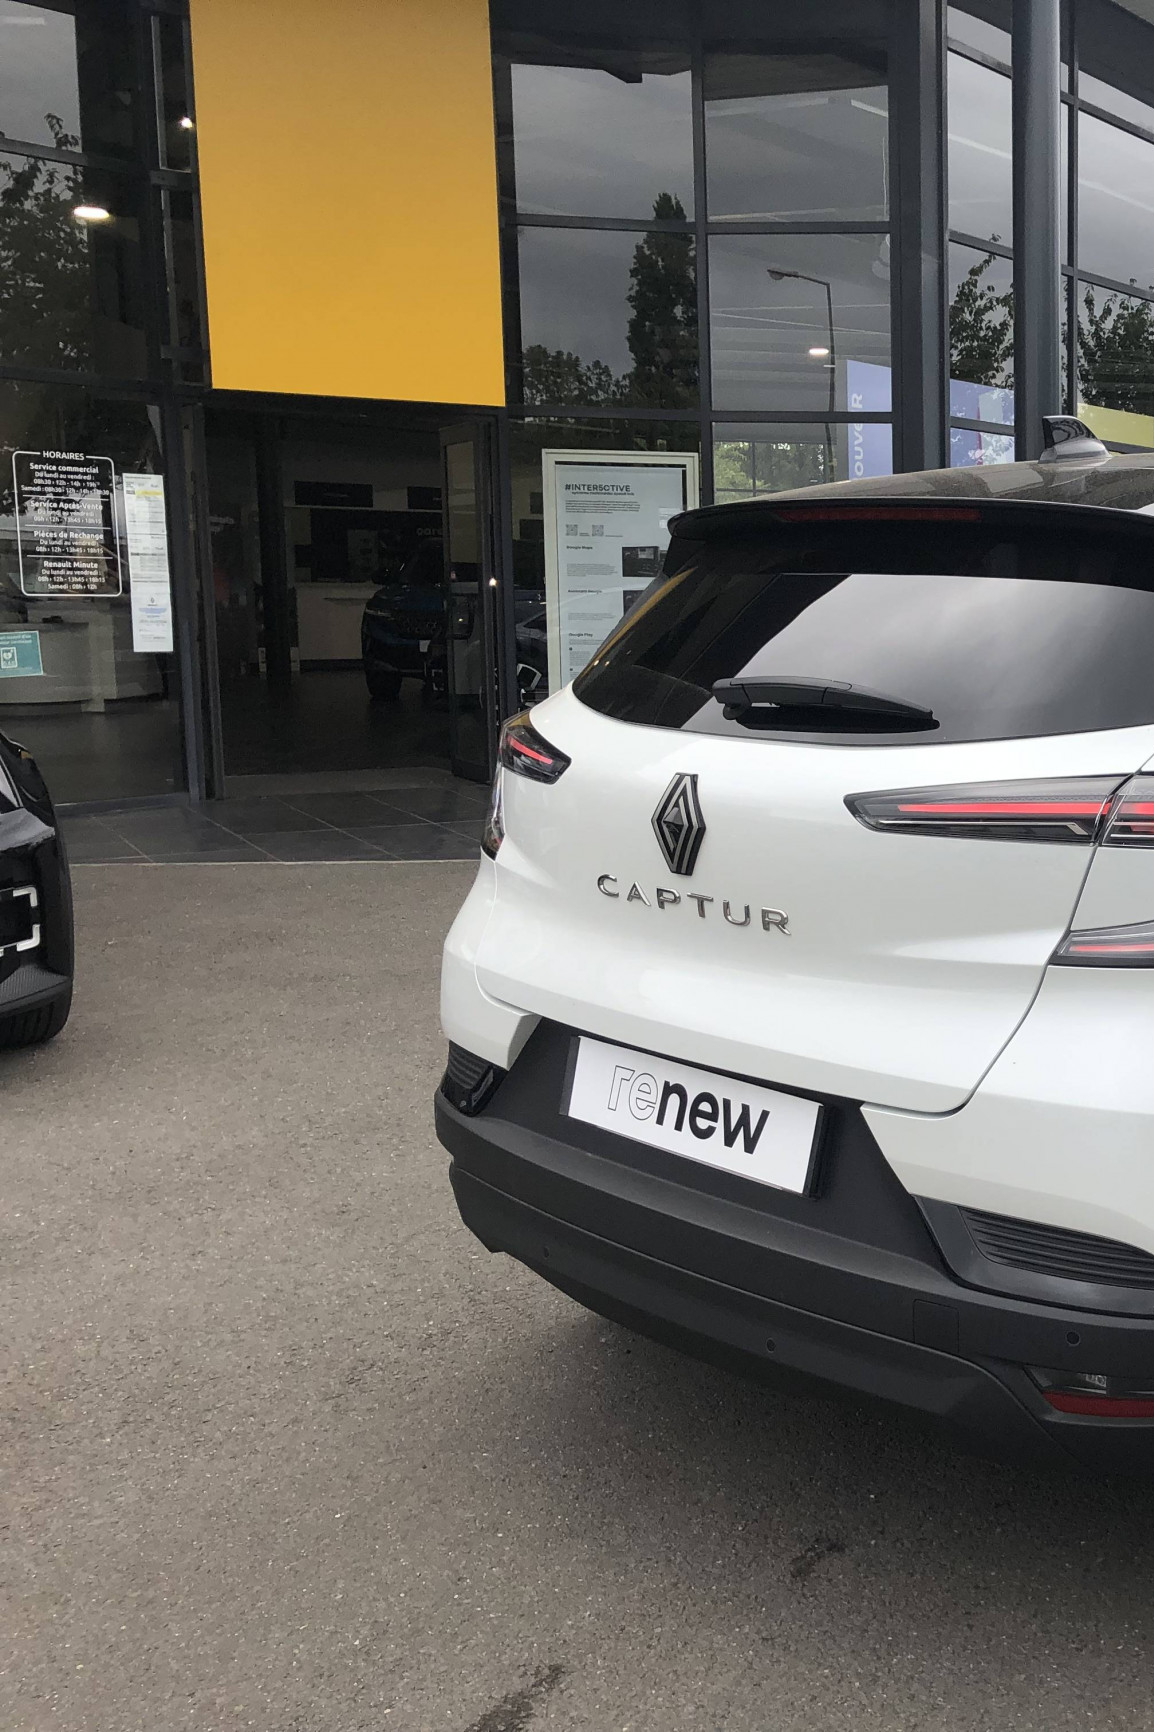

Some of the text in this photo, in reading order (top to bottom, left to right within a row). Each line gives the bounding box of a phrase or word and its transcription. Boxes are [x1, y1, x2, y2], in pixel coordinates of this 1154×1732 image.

[43, 450, 85, 460] HORAIRES
[29, 462, 99, 474] Service commercial
[30, 500, 58, 509] Service
[69, 531, 104, 541] Rechange
[43, 560, 99, 569] Renault Minute
[596, 873, 791, 936] CAPTUR
[606, 1064, 770, 1155] renew
